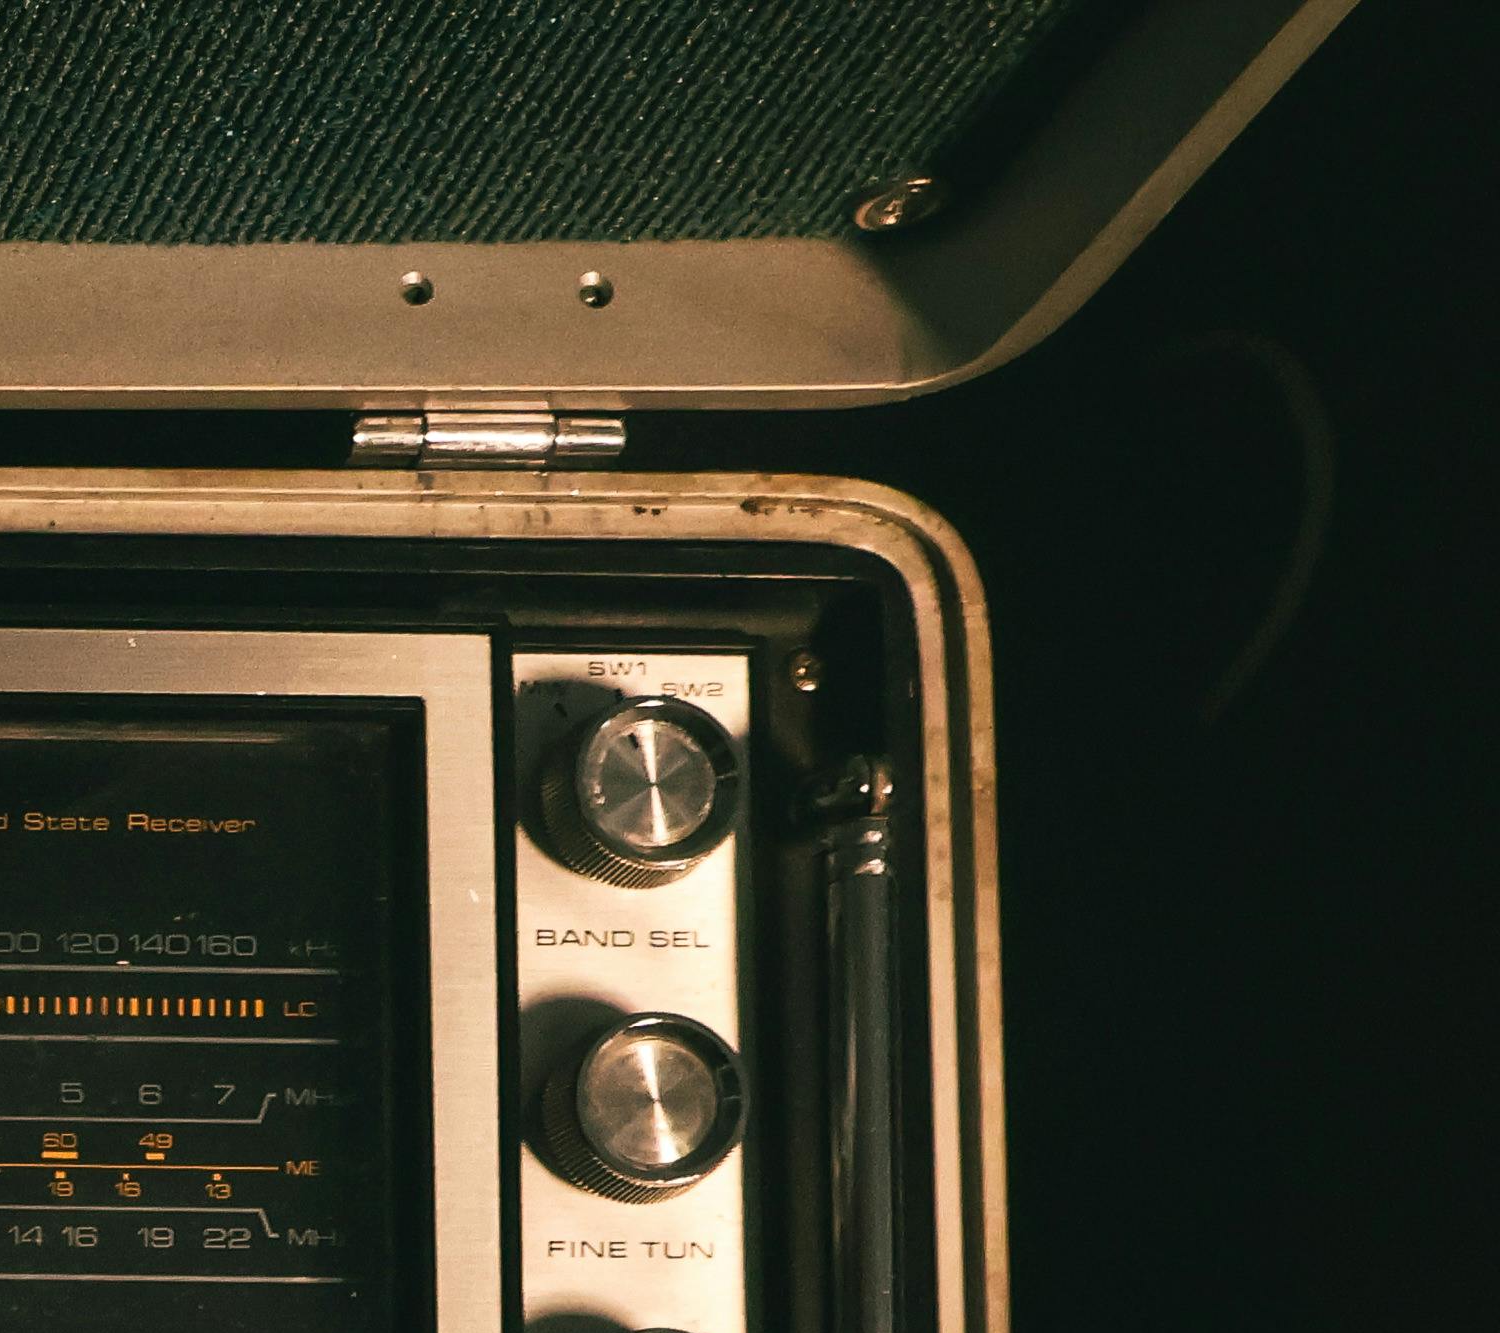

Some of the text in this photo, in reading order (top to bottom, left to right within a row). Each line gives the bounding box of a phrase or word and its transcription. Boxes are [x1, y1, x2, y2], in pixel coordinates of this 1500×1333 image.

[587, 661, 647, 676] SW1
[661, 682, 724, 698] SW2
[23, 811, 110, 832] State
[127, 813, 257, 833] Receiver
[56, 932, 119, 955] 120
[129, 933, 190, 956] 140
[197, 934, 257, 957] 160
[536, 929, 711, 948] BAND SEL
[60, 1082, 85, 1104] 5
[138, 1083, 163, 1105] 6
[214, 1084, 236, 1105] 7
[42, 1133, 77, 1149] 60
[138, 1133, 174, 1149] 49
[47, 1181, 74, 1197] 19
[204, 1183, 232, 1199] 13
[8, 1226, 43, 1247] 14
[61, 1227, 99, 1248] 16
[138, 1227, 175, 1249] 19
[203, 1228, 252, 1250] 22
[547, 1240, 715, 1259] FINE TUN
